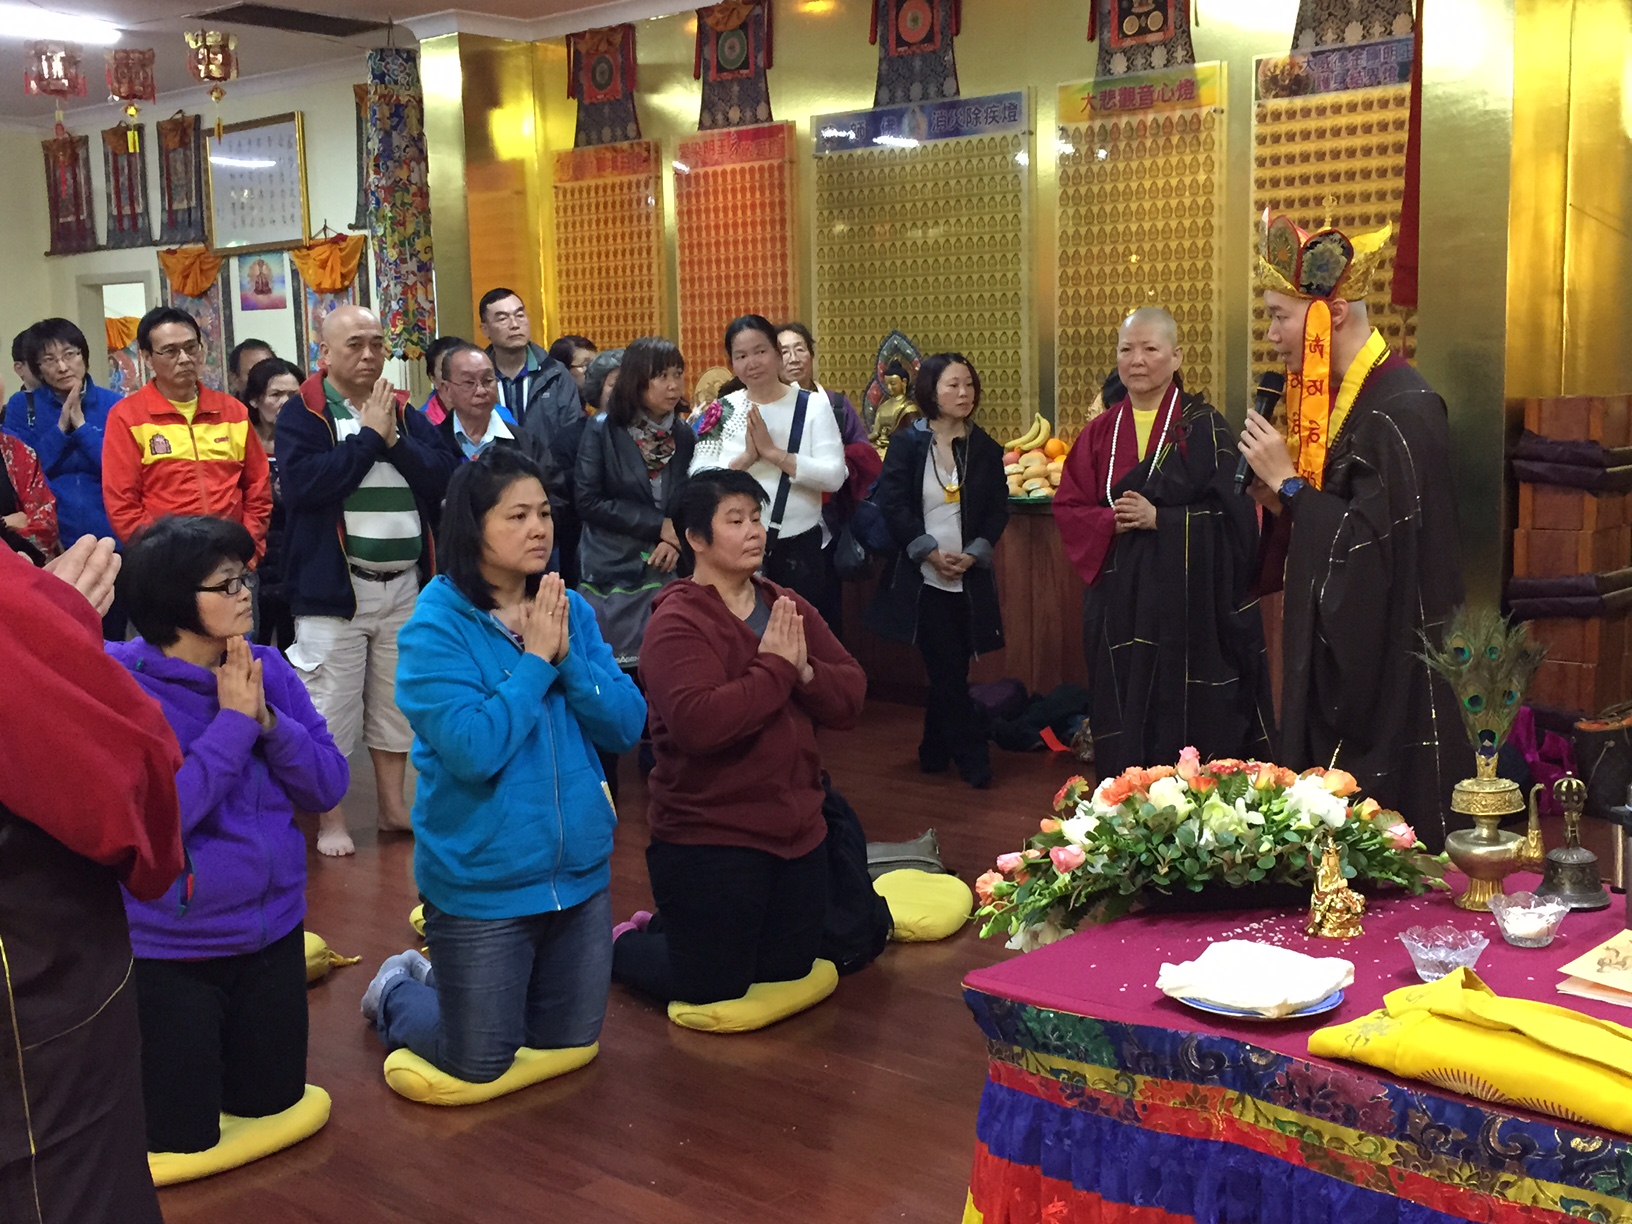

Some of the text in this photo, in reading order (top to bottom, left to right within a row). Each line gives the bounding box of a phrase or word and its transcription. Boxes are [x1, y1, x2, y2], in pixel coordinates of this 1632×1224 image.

[1080, 78, 1196, 113] 大悲觀音心燈
